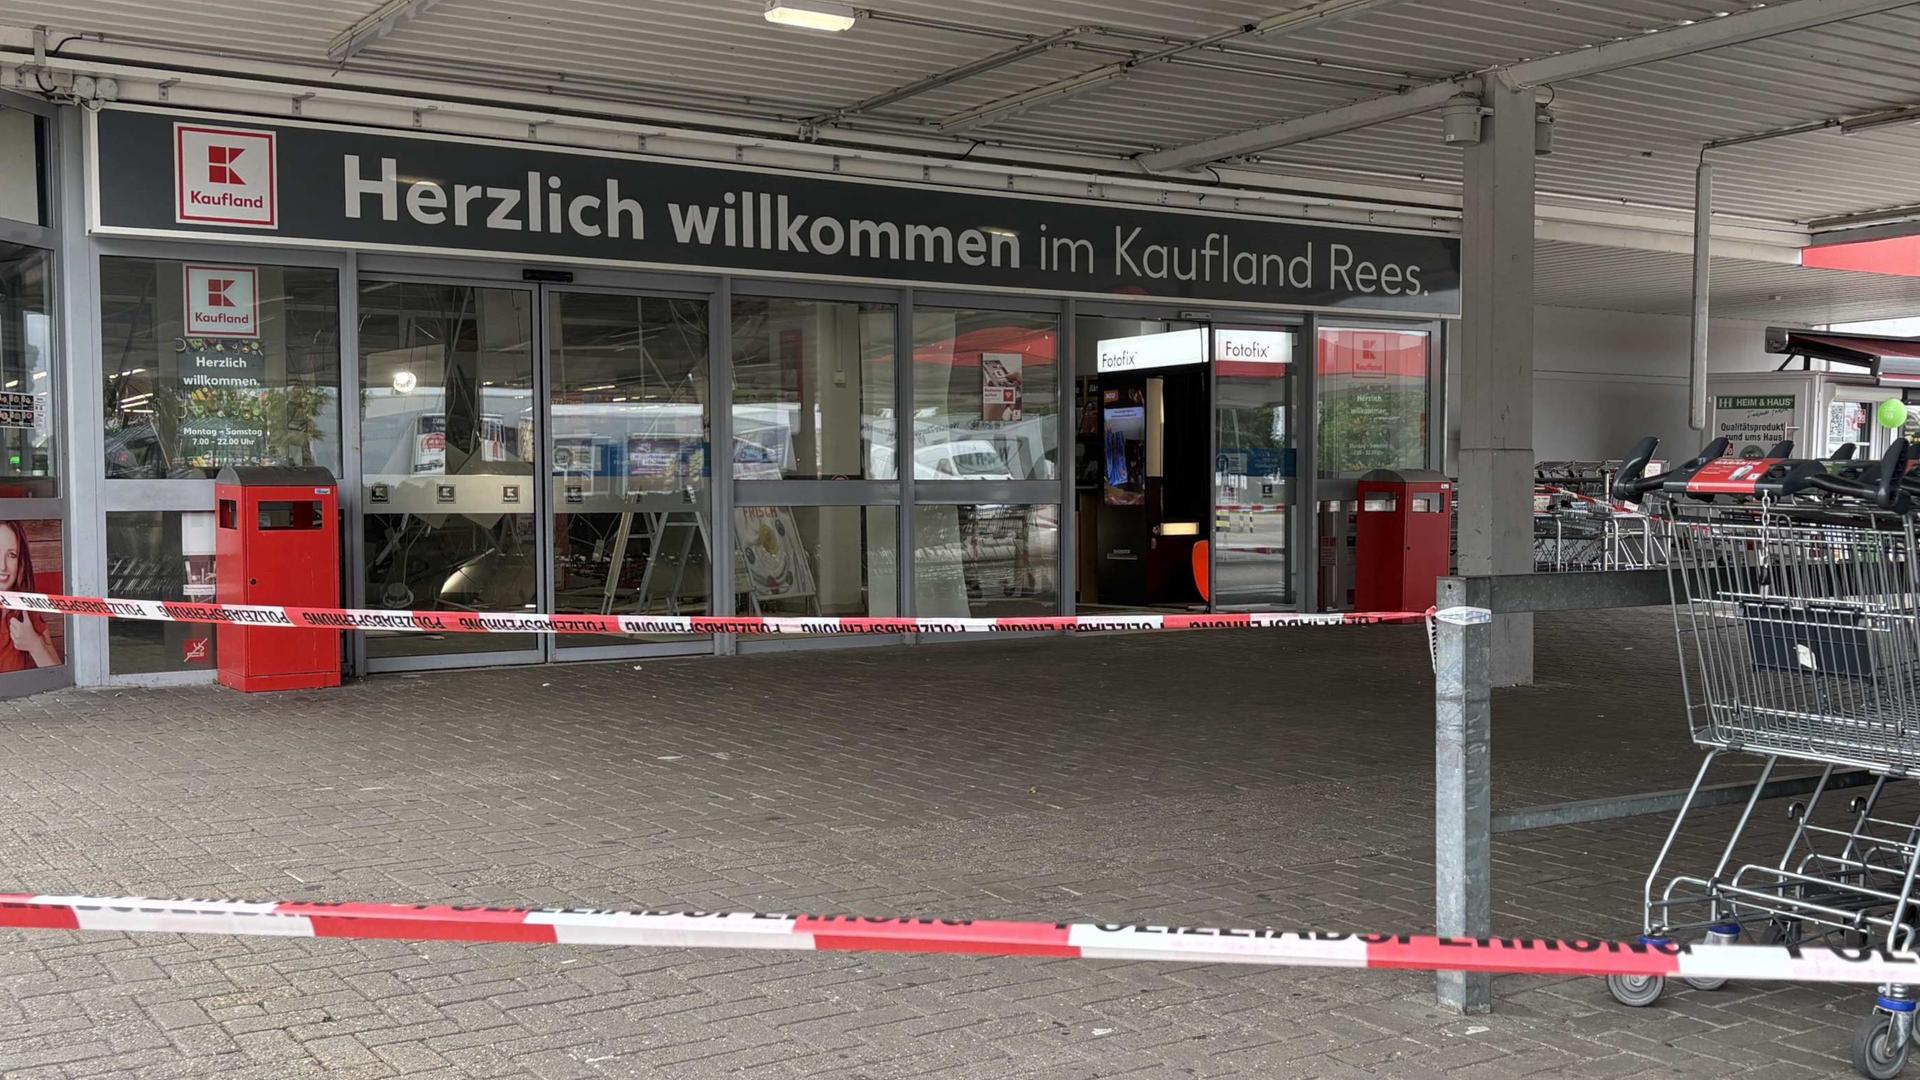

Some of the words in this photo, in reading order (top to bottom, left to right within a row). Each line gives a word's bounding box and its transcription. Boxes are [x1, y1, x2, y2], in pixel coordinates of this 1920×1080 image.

[190, 190, 263, 208] Kaufland
[344, 154, 644, 240] Herzlich
[667, 191, 1021, 269] willkommen
[1039, 223, 1094, 274] im
[1114, 225, 1312, 289] Kaufland
[1329, 243, 1430, 297] Rees.
[195, 312, 248, 324] Kaufland
[1225, 341, 1268, 358] Fotofix
[196, 356, 247, 368] Herzlich
[1102, 351, 1135, 368] Fotofix
[183, 375, 260, 386] willkommen.
[1736, 398, 1757, 407] HEIM
[1759, 398, 1765, 406] &
[1767, 398, 1791, 407] HAUS
[183, 427, 217, 437] Montag
[225, 427, 263, 437] Samstag
[1720, 422, 1785, 432] Qualitätsprodukt
[192, 438, 209, 446] 7.00
[217, 438, 239, 446] 22.00
[240, 438, 255, 446] Uhr
[1725, 433, 1742, 441] rund
